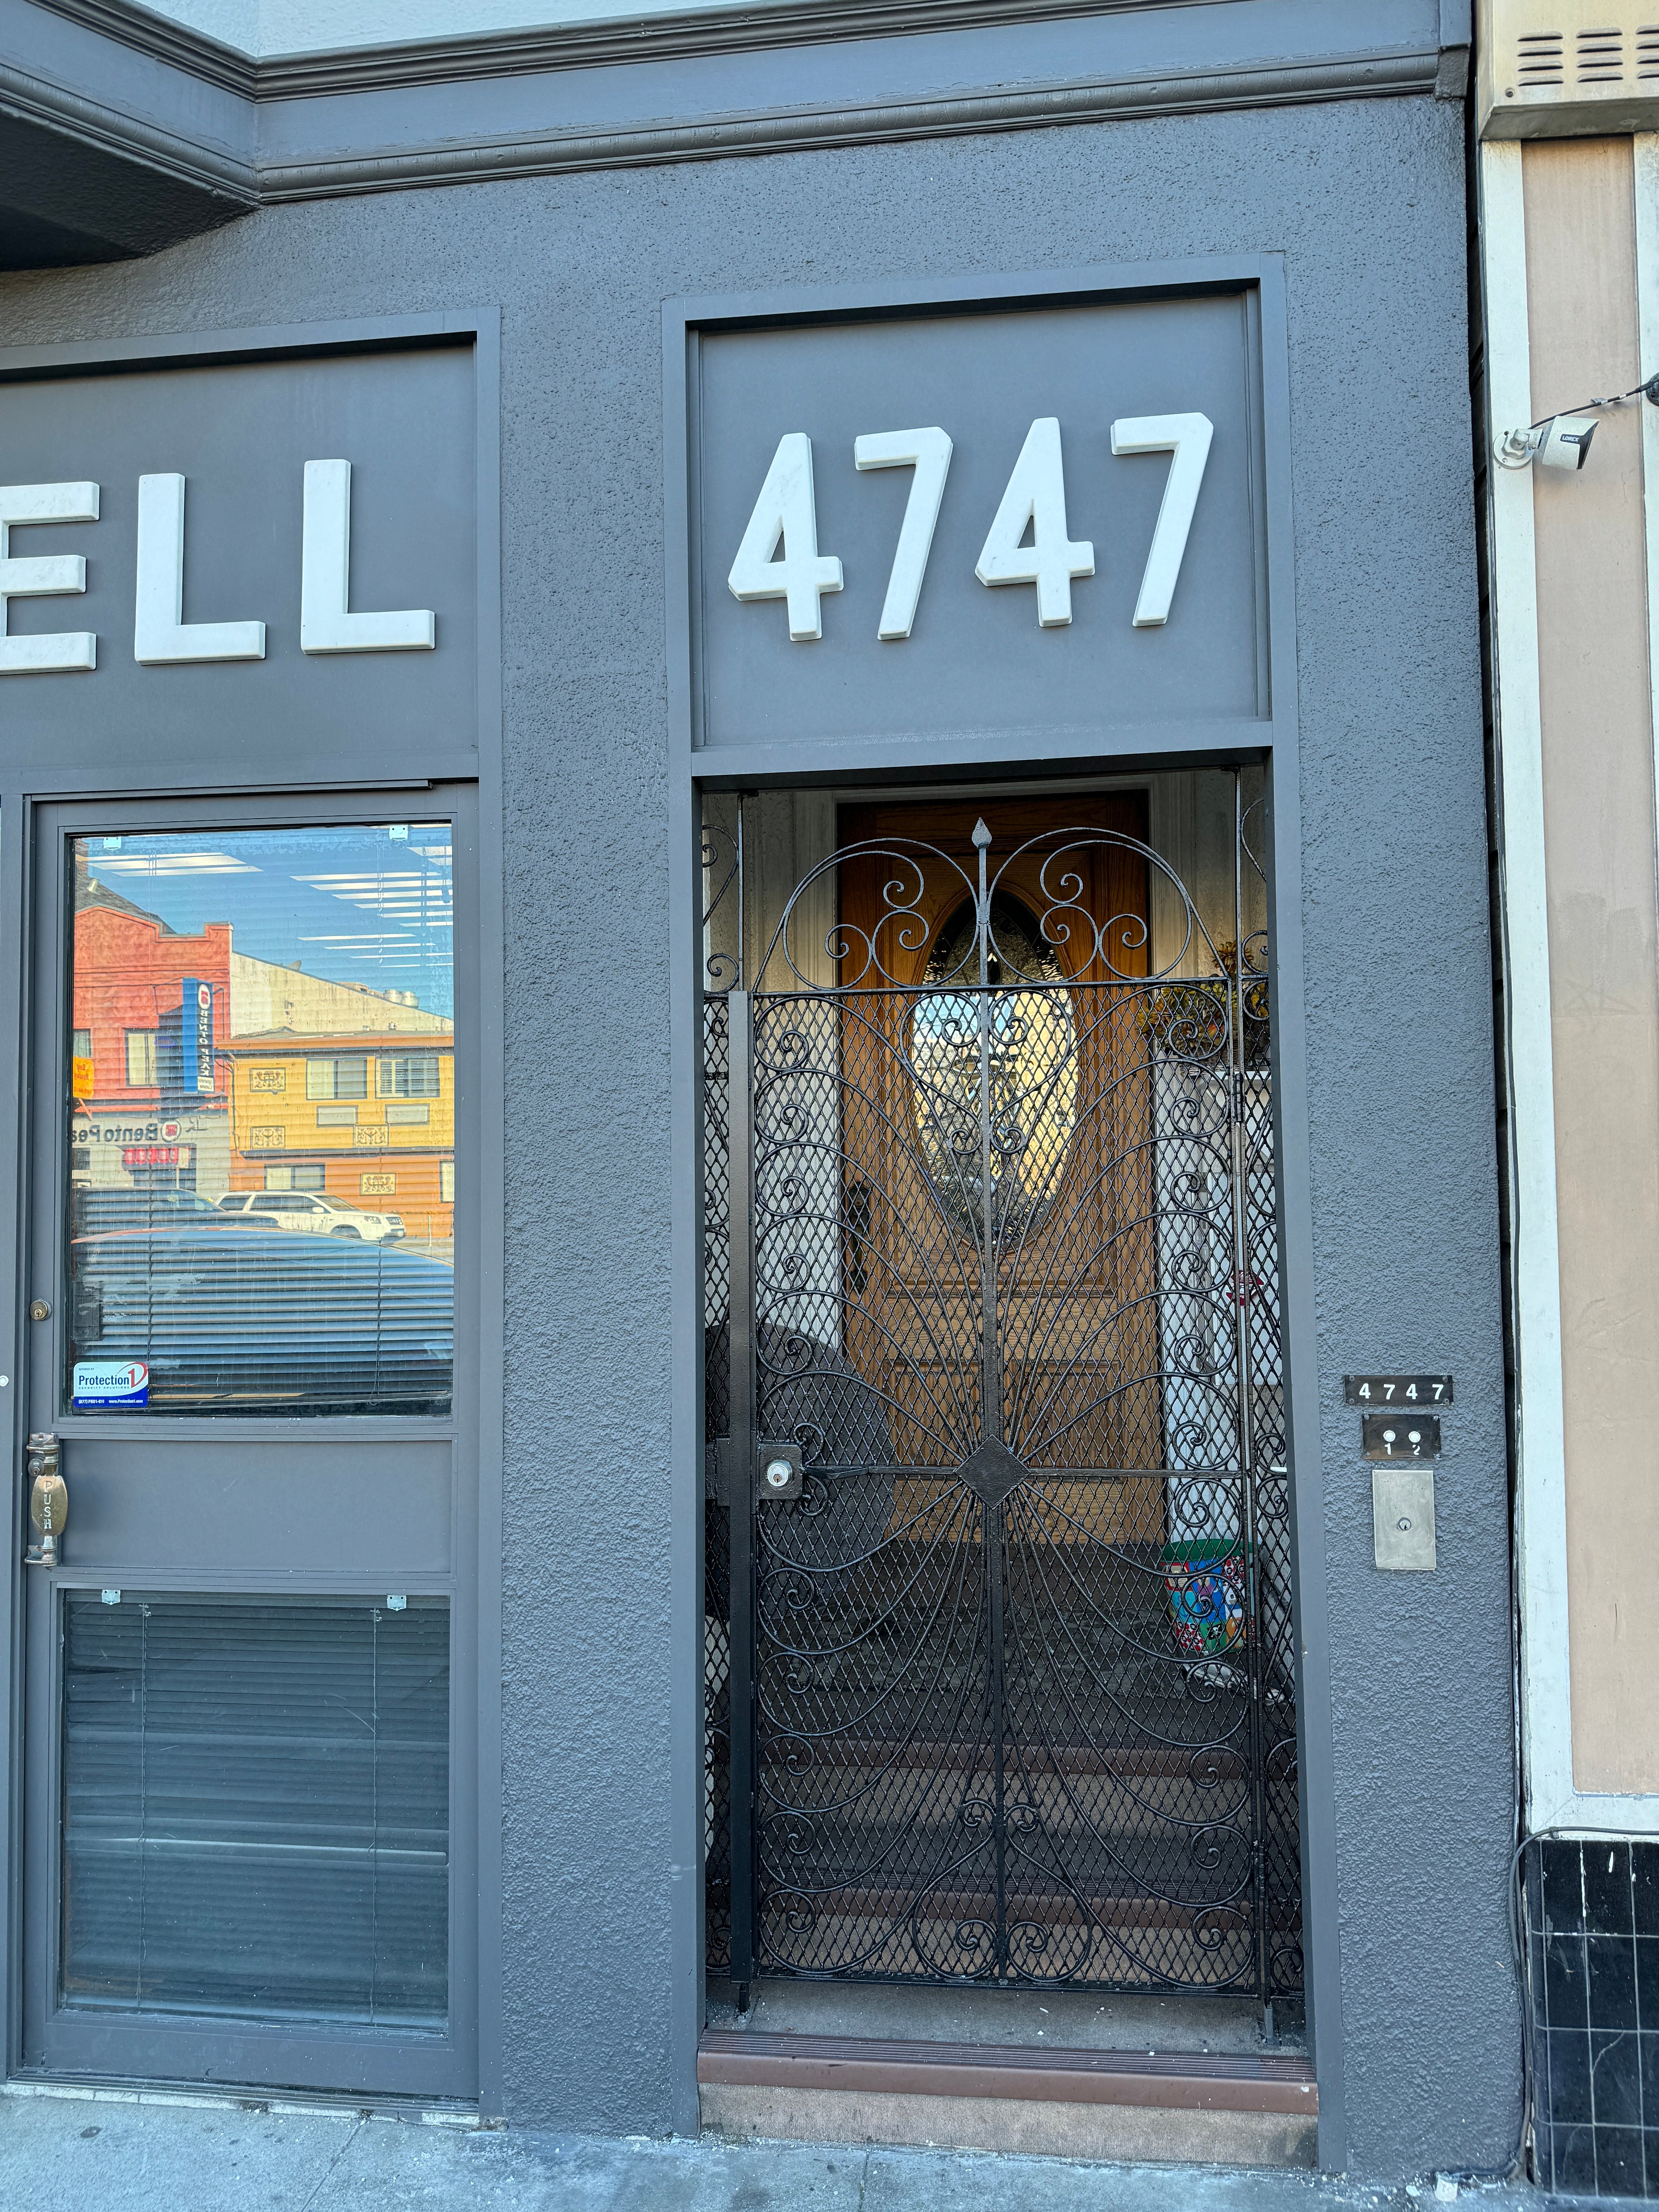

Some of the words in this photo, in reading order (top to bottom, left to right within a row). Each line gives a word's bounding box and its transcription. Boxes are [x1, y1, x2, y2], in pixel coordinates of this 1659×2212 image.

[728, 412, 1214, 642] 4747
[0, 459, 435, 676] ELL
[1359, 1383, 1444, 1400] 4747
[1384, 1443, 1392, 1455] 1
[1412, 1444, 1421, 1455] 2
[43, 1480, 52, 1529] PUSH
